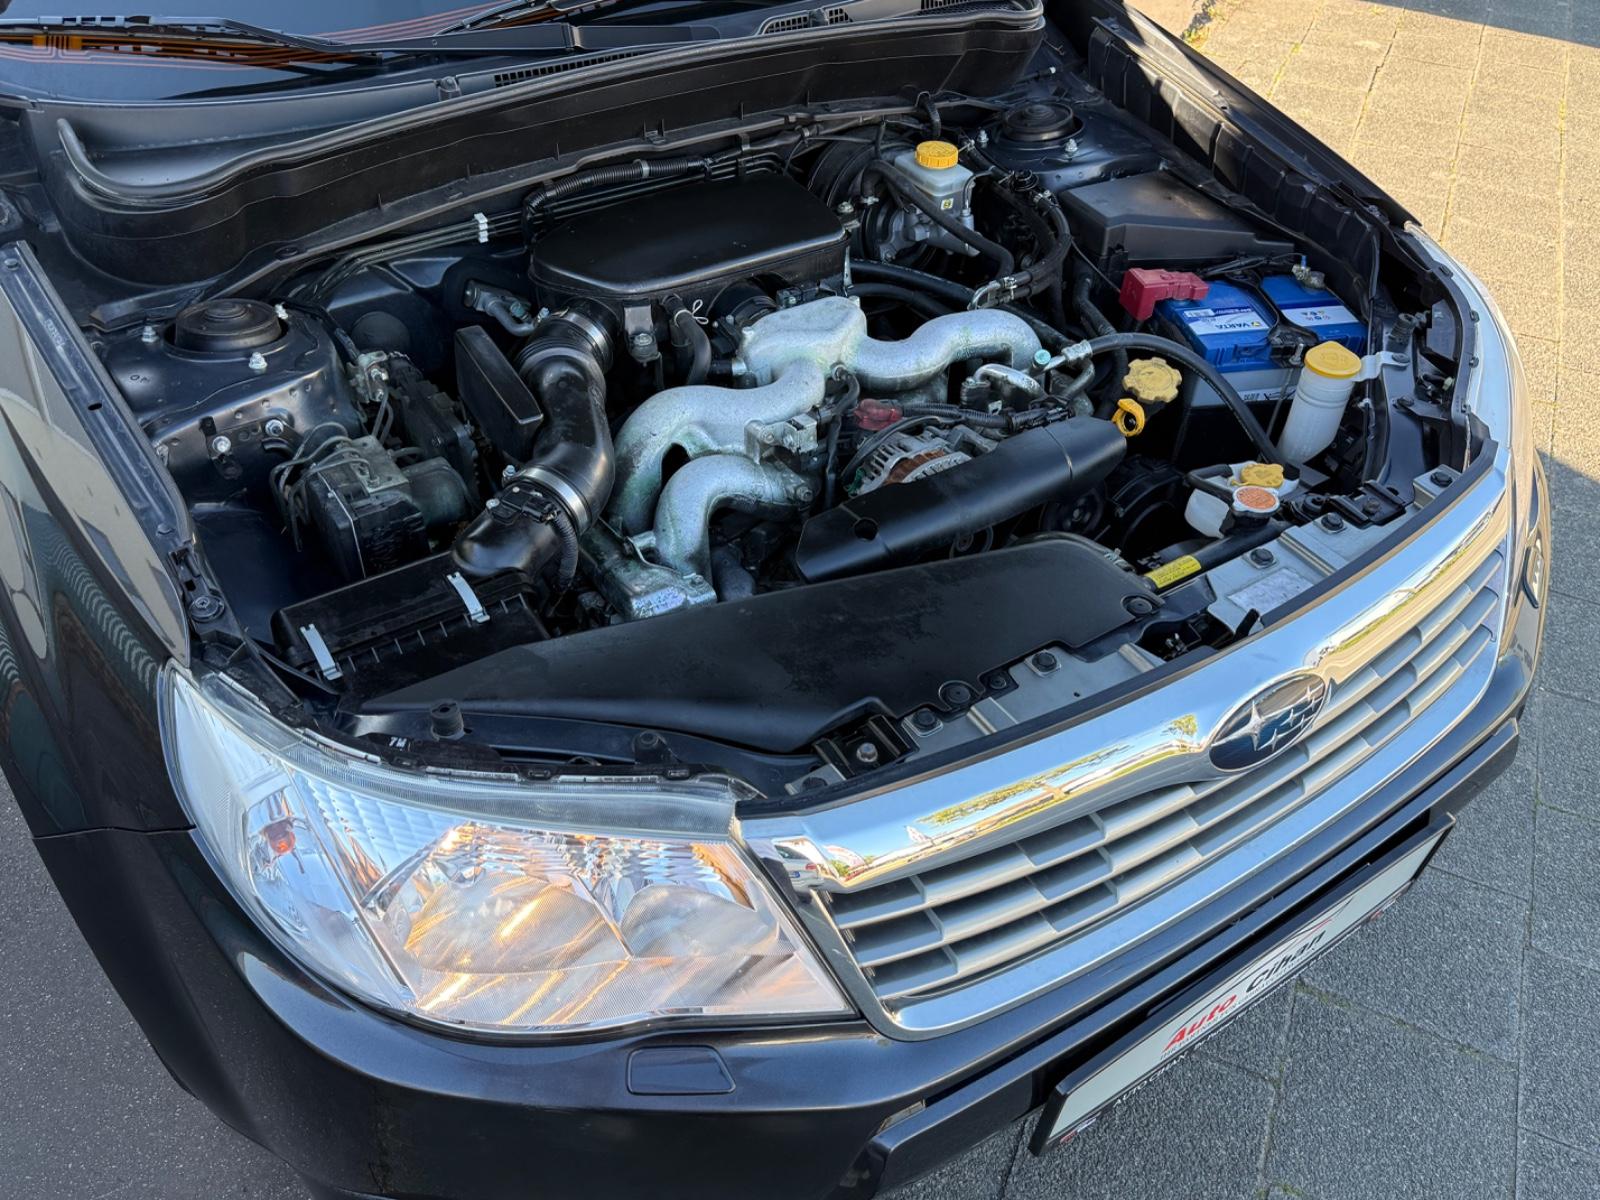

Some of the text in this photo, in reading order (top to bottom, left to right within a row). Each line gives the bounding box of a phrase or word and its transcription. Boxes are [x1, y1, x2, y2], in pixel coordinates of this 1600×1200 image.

[1162, 994, 1237, 1053] Auto
[1246, 930, 1326, 993] Cihan
[1112, 1080, 1148, 1108] AUTO
